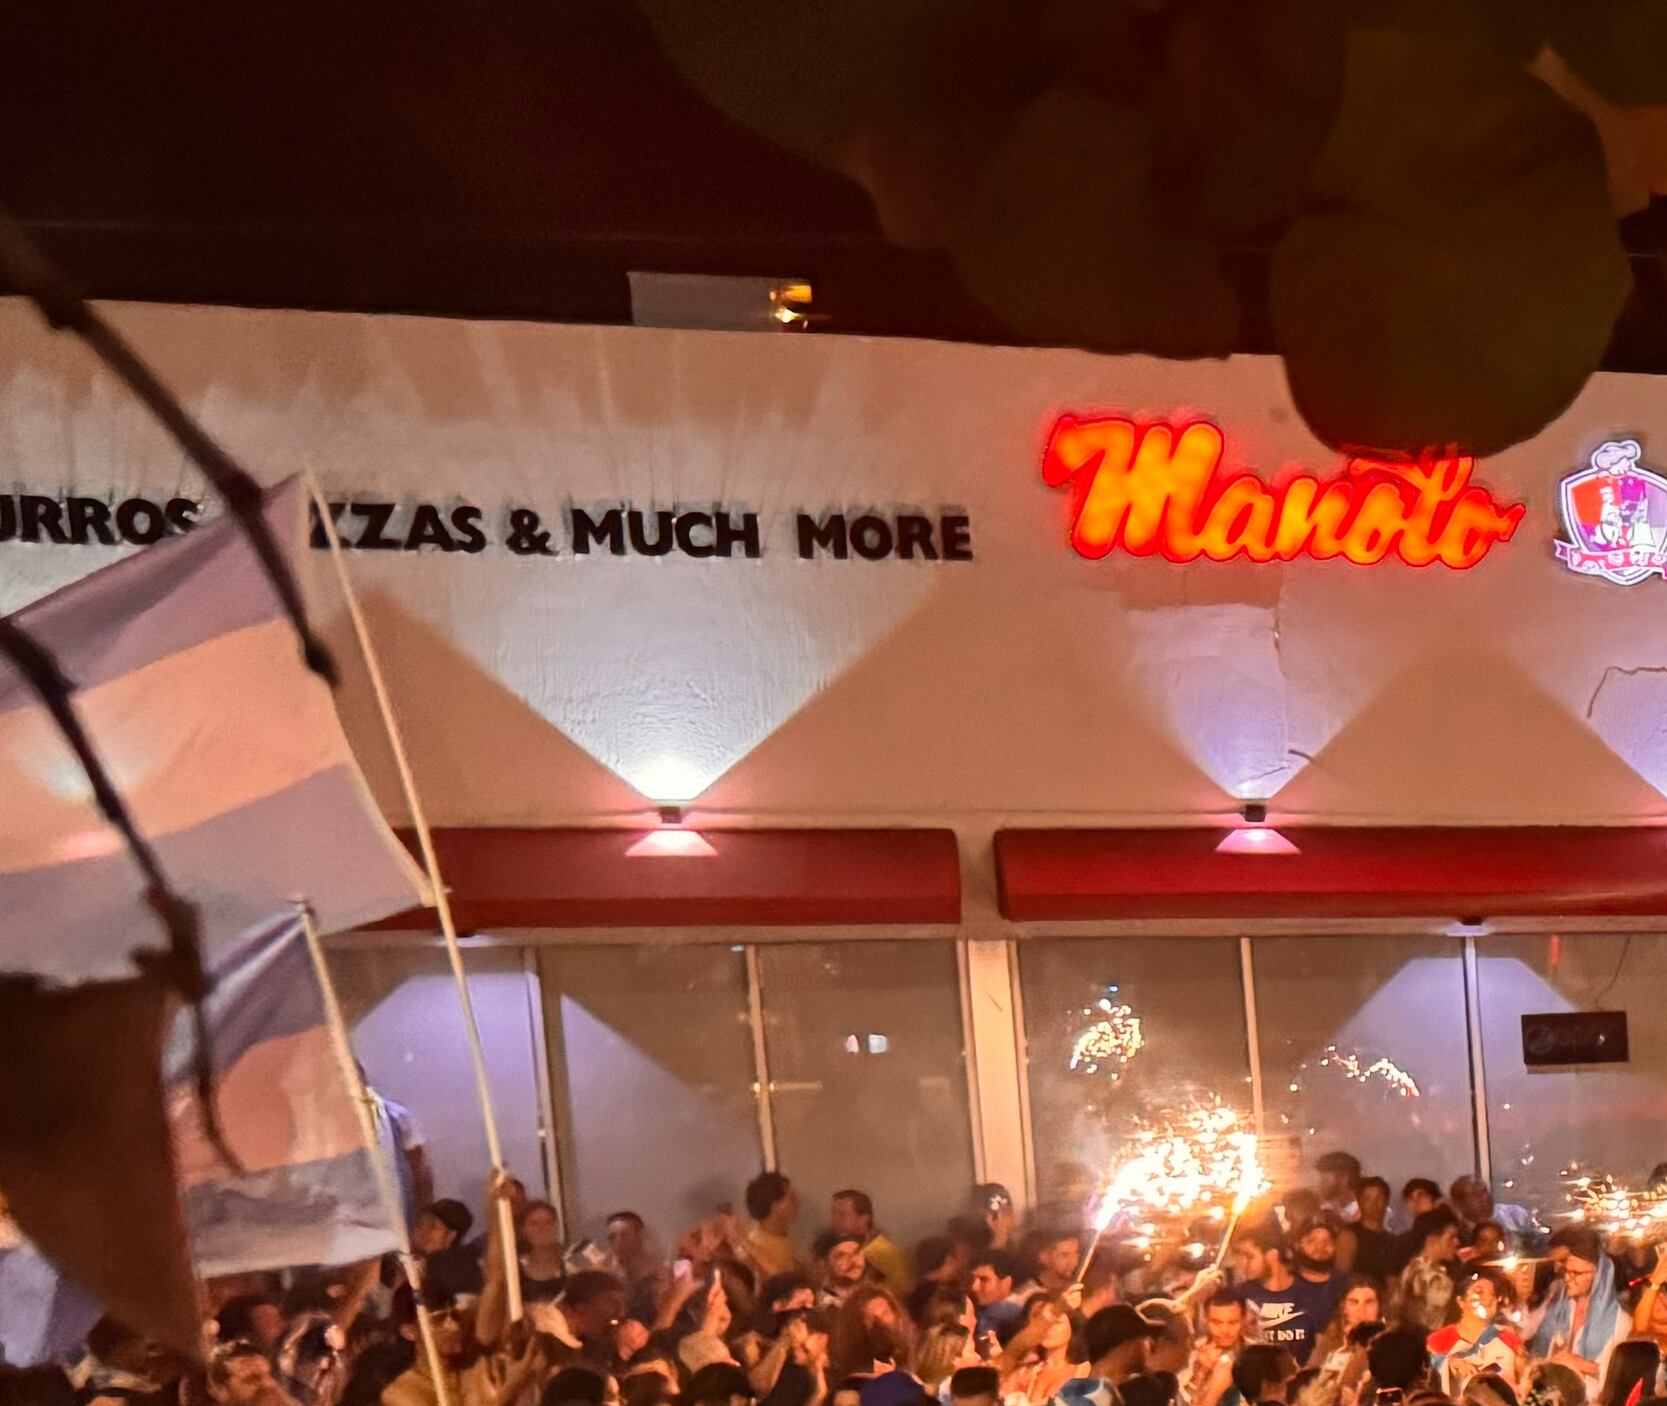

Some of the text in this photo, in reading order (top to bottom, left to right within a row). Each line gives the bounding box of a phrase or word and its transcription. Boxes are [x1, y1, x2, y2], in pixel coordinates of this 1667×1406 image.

[0, 495, 199, 545] RROS
[506, 508, 557, 556] &
[572, 509, 761, 558] MUCH
[796, 513, 975, 561] MORE
